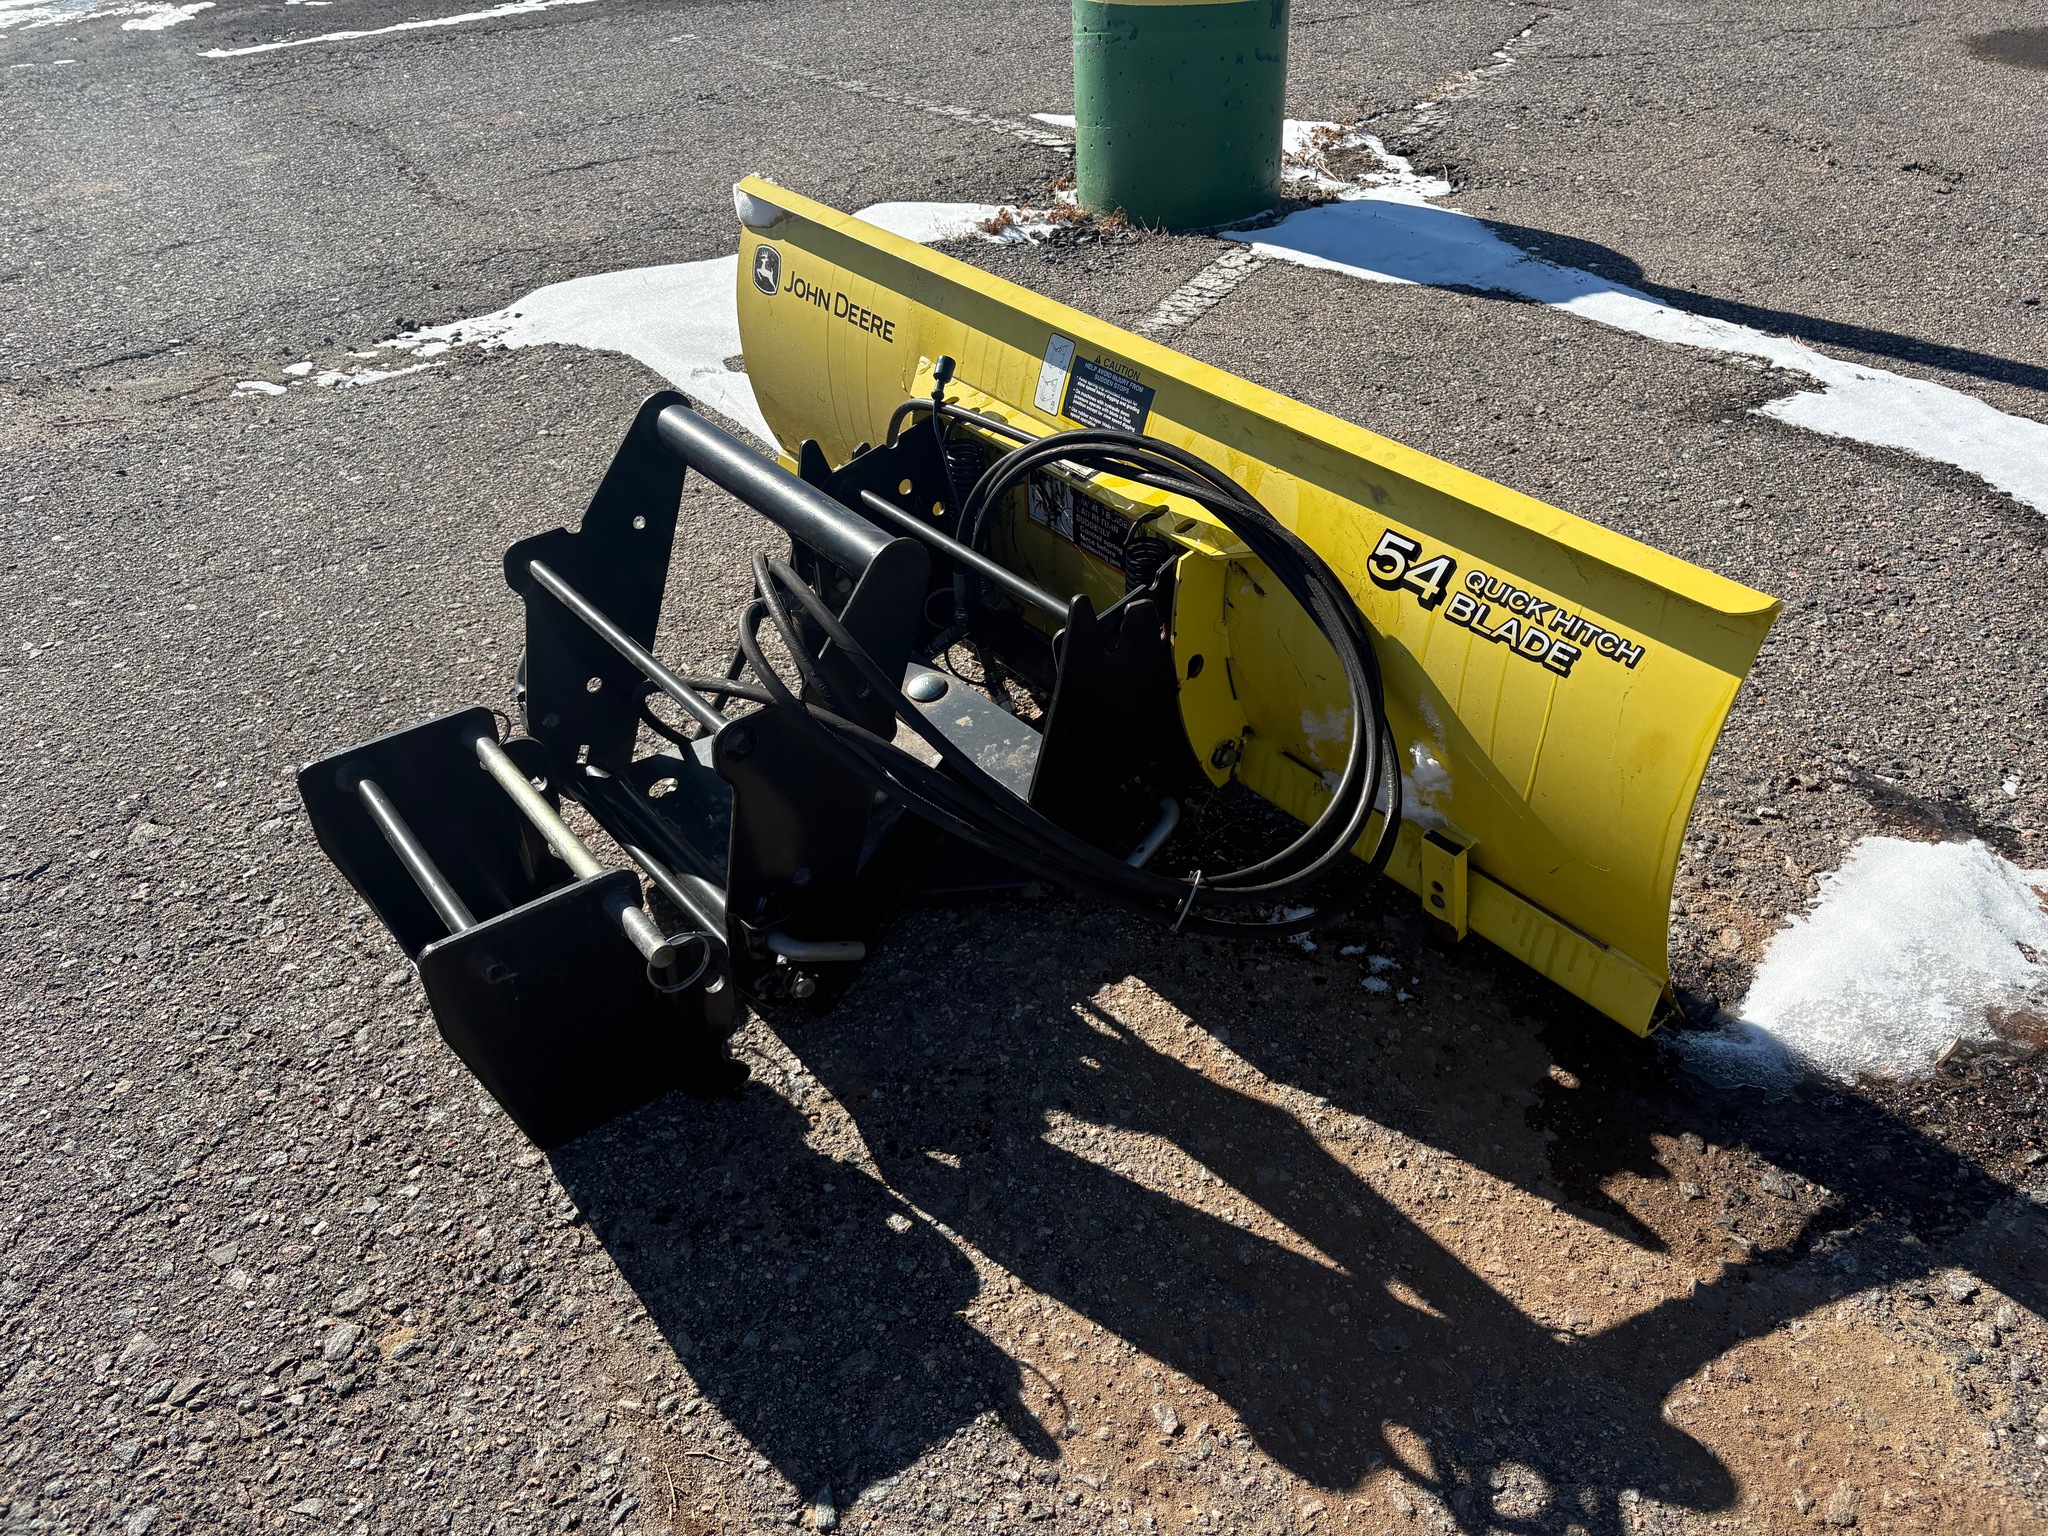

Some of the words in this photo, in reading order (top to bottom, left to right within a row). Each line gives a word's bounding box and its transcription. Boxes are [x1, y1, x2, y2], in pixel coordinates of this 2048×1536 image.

[784, 271, 831, 311] JOHN
[834, 291, 895, 344] DEERE
[1085, 362, 1097, 372] HELP
[1097, 369, 1111, 378] AVOID
[1112, 374, 1129, 386] INJURY
[1129, 382, 1144, 393] FROM
[1104, 358, 1140, 380] CAUTION
[1094, 374, 1112, 387] SUDDEN
[1113, 383, 1129, 394] STOPS
[1126, 404, 1140, 414] grading
[1076, 514, 1110, 538] SUDDENLY
[1092, 514, 1119, 533] RETURN
[1080, 525, 1103, 542] Control
[1104, 540, 1123, 555] spring
[1097, 542, 1116, 557] before
[1080, 542, 1109, 561] removing
[1109, 557, 1121, 567] jam
[1367, 528, 1457, 611] 54
[1465, 570, 1557, 626] QUICK
[1549, 607, 1646, 669] HITCH
[1444, 591, 1582, 679] BLADE
